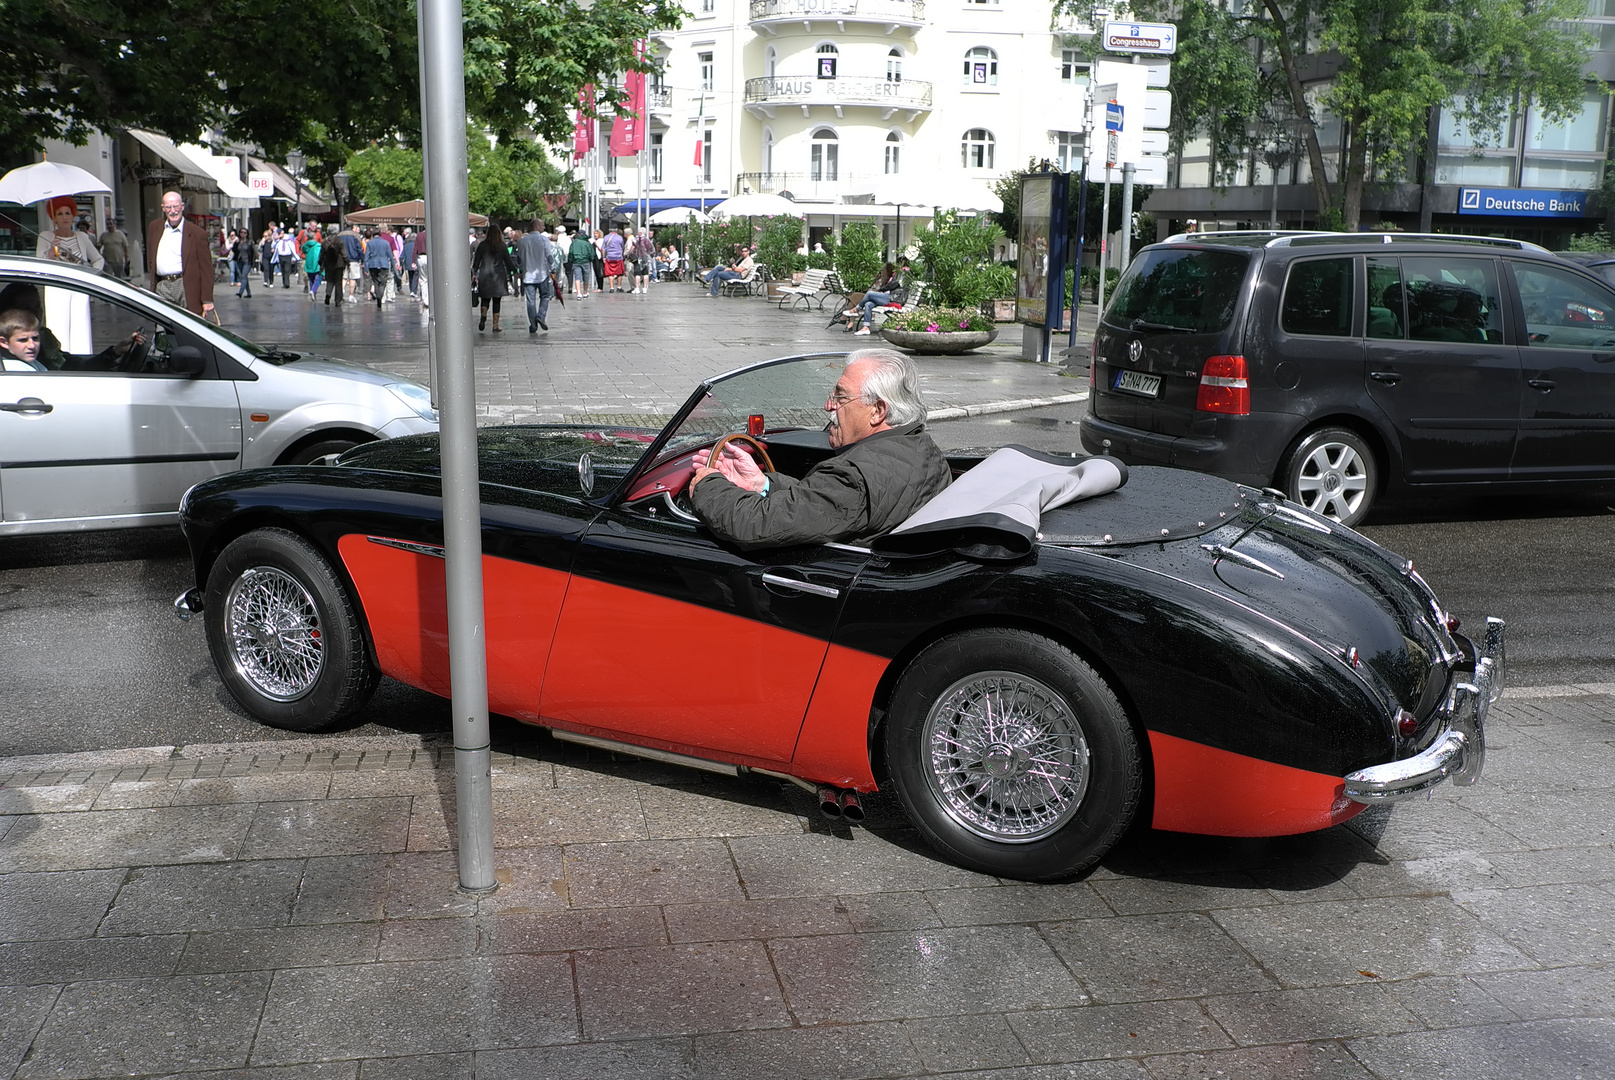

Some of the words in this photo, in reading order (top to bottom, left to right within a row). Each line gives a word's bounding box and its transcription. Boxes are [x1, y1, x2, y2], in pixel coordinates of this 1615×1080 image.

[1110, 37, 1159, 47] Congresshaus
[775, 82, 812, 95] HAUS
[254, 179, 268, 189] DB
[1485, 197, 1545, 211] Deutsche
[1549, 199, 1581, 212] Bank
[1141, 376, 1160, 393] 777
